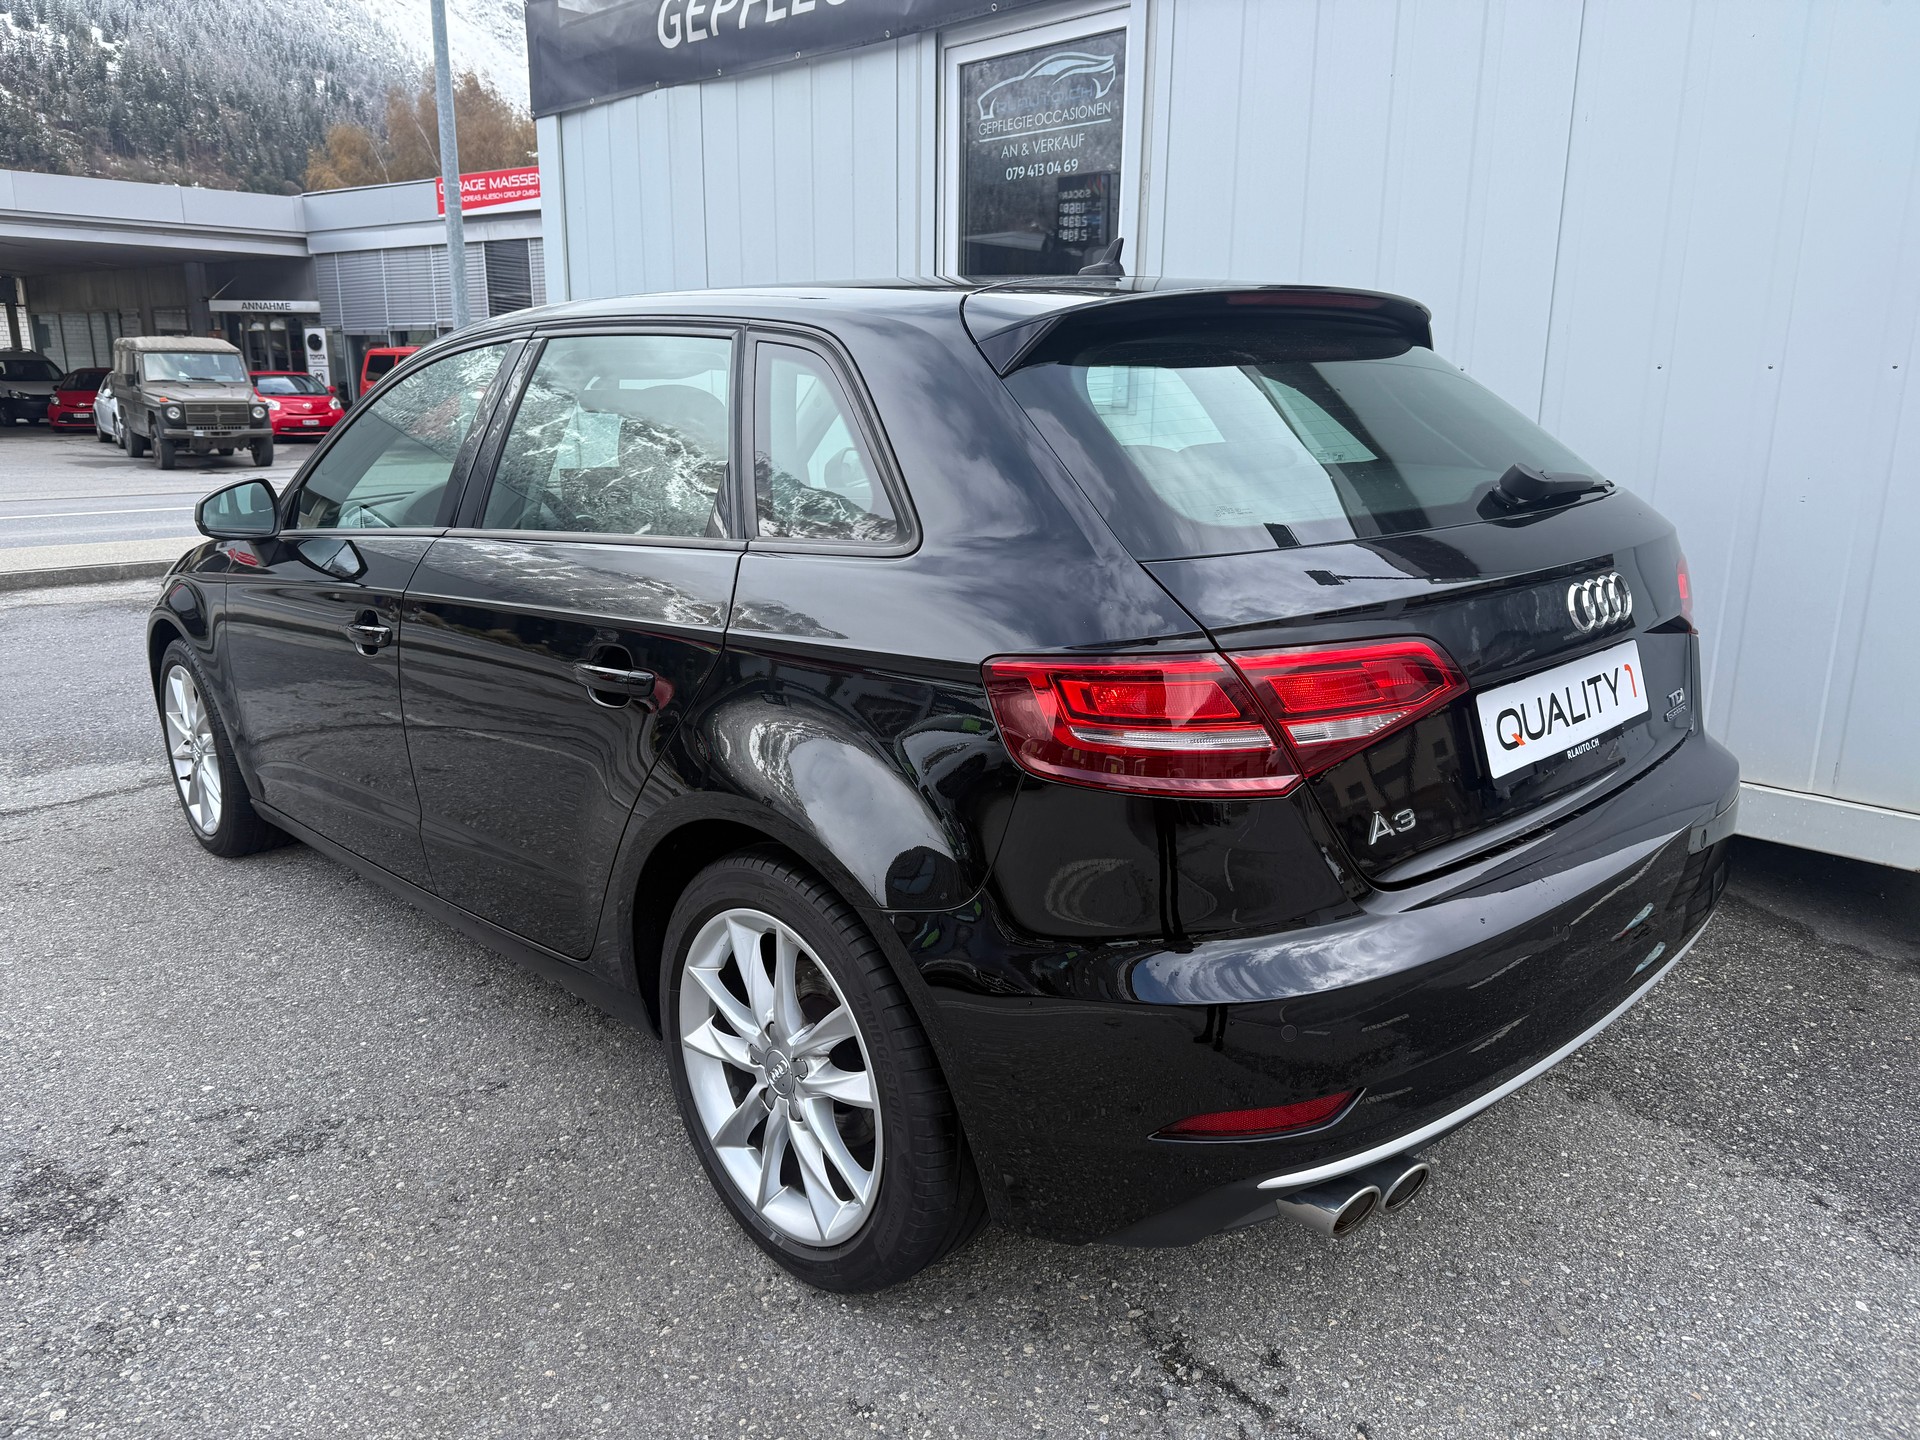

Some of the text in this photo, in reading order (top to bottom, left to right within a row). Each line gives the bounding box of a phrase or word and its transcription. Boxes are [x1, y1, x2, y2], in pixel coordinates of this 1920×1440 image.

[657, 0, 847, 48] GEPF
[979, 101, 1112, 136] GEPFLEGTE OCCASIONEN
[1001, 133, 1085, 159] AN & VERKAUF
[1005, 158, 1079, 181] 079 413 04 69
[439, 178, 486, 195] GRAGE
[241, 302, 292, 311] ANNAHME
[1566, 738, 1600, 760] RLAUTO.CH
[1368, 808, 1416, 846] A3
